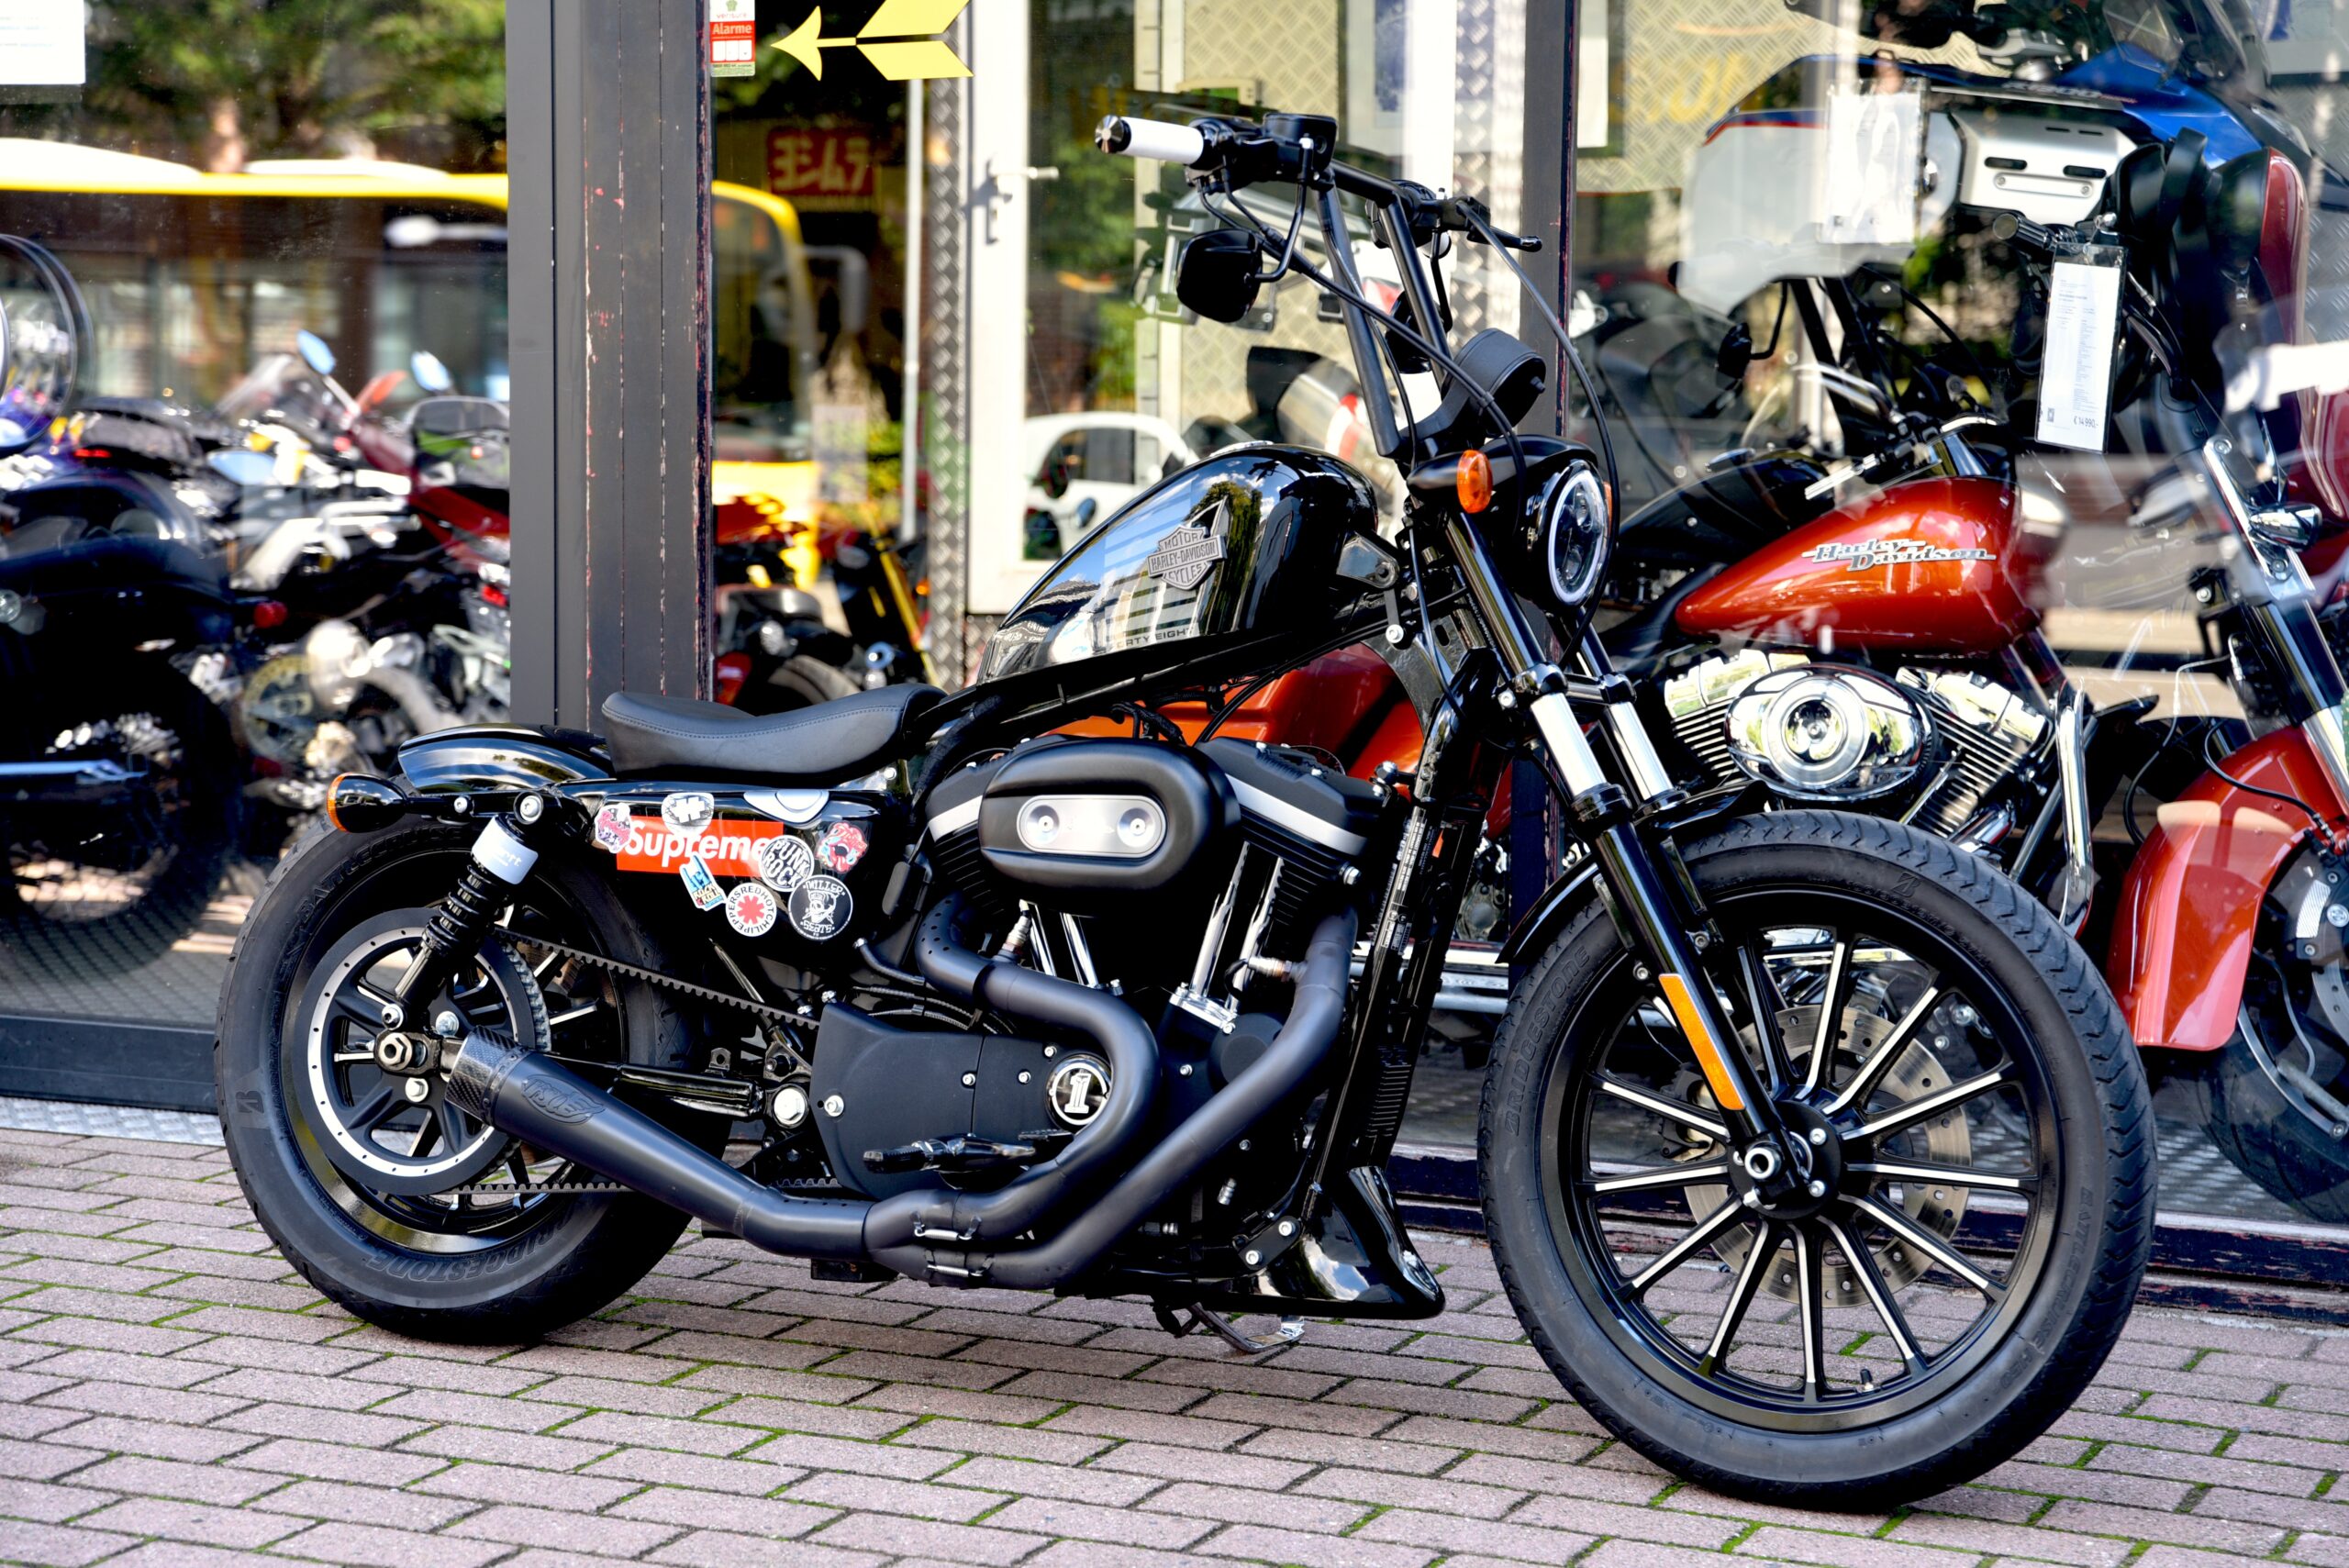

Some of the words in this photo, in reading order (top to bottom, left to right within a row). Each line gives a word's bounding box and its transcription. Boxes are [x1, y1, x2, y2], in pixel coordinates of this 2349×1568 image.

[712, 23, 752, 35] Alarme
[1163, 532, 1199, 550] MOTOR
[1809, 538, 1920, 562] Harley
[1151, 543, 1216, 571] HARLEY-DAVIDSON
[1847, 546, 1993, 572] Davidson
[1168, 562, 1203, 584] CYCLES
[624, 820, 769, 867] Supreme
[763, 851, 802, 888] ROCK
[771, 840, 810, 878] PUNK
[692, 883, 716, 899] ROCK
[806, 880, 843, 895] MILLER
[1504, 944, 1591, 1137] BRIDGESTONE
[2031, 1186, 2094, 1349] BATTLECRUISE
